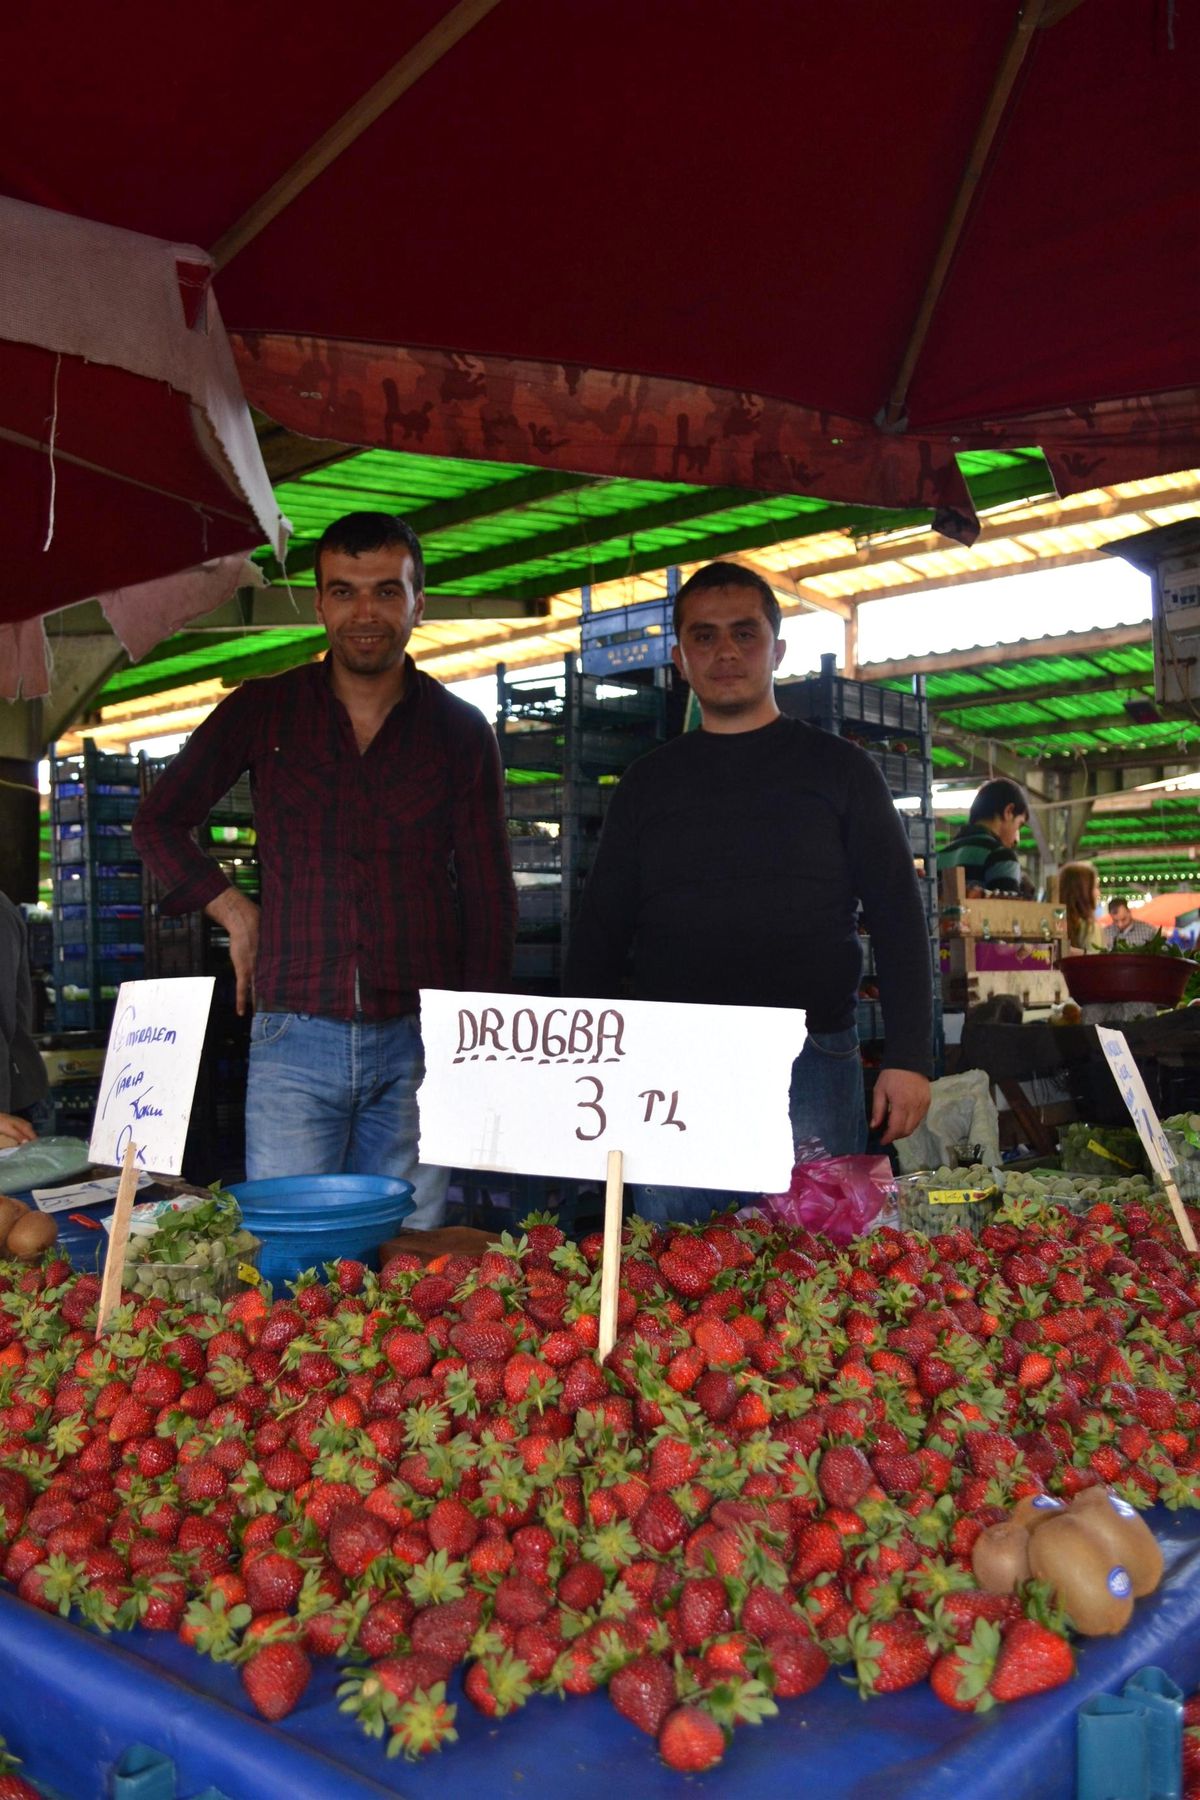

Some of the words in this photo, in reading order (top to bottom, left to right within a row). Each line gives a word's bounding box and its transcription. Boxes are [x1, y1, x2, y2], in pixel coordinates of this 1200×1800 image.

[454, 1008, 626, 1058] DROGBA
[575, 1075, 607, 1141] 3
[638, 1089, 687, 1132] TL
